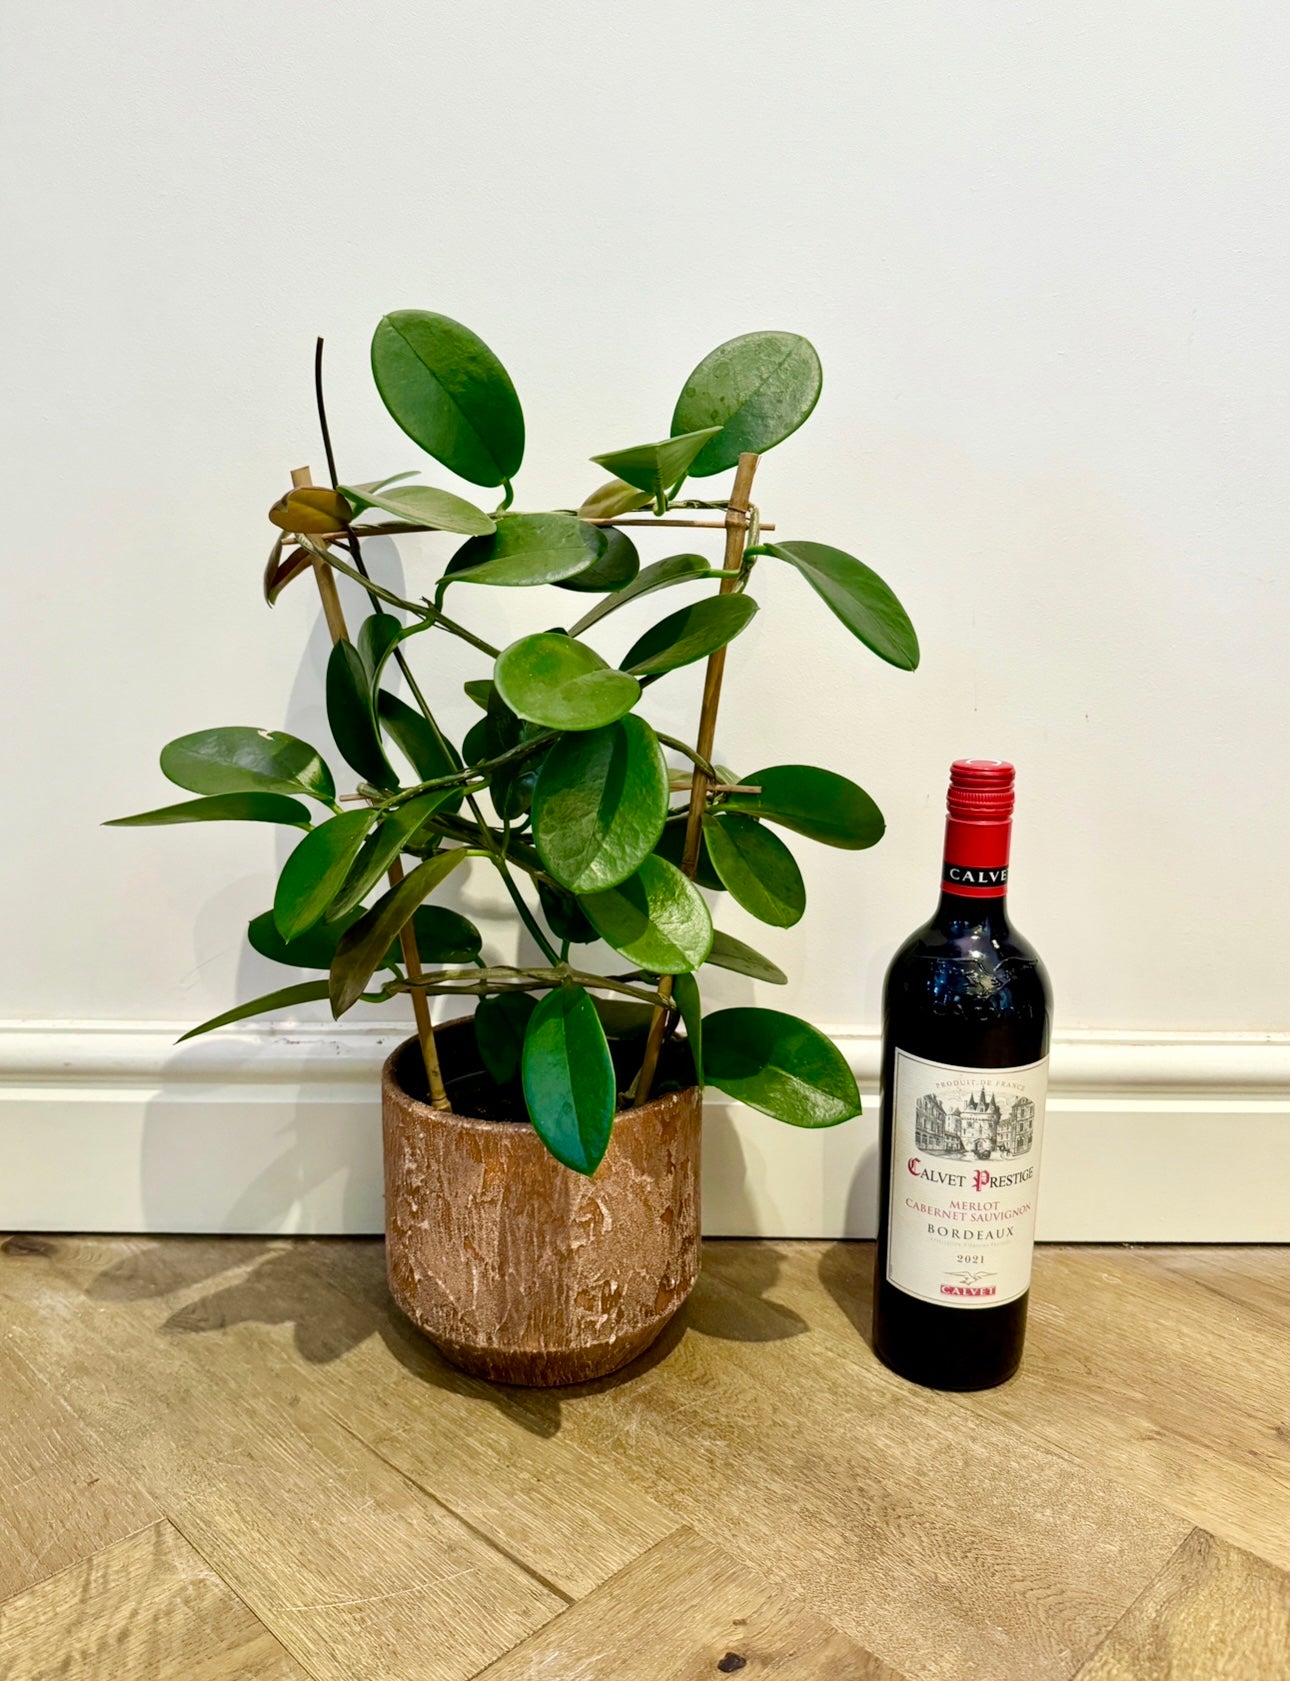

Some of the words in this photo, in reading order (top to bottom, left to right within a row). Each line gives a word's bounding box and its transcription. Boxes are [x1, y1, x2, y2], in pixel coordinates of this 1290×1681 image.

[949, 867, 1007, 883] CALVE
[935, 1079, 977, 1089] PRODUIT
[980, 1079, 992, 1087] DE
[995, 1080, 1026, 1092] FRANCE
[907, 1157, 966, 1187] CALVET
[971, 1166, 1034, 1192] PRESTIGE
[905, 1198, 967, 1221] CABERNET
[970, 1202, 1032, 1222] SAUVIGNON
[949, 1200, 1000, 1211] MERLOT
[927, 1223, 1014, 1240] BORDEAUX
[957, 1254, 984, 1264] 2021
[941, 1285, 996, 1296] CALVET
